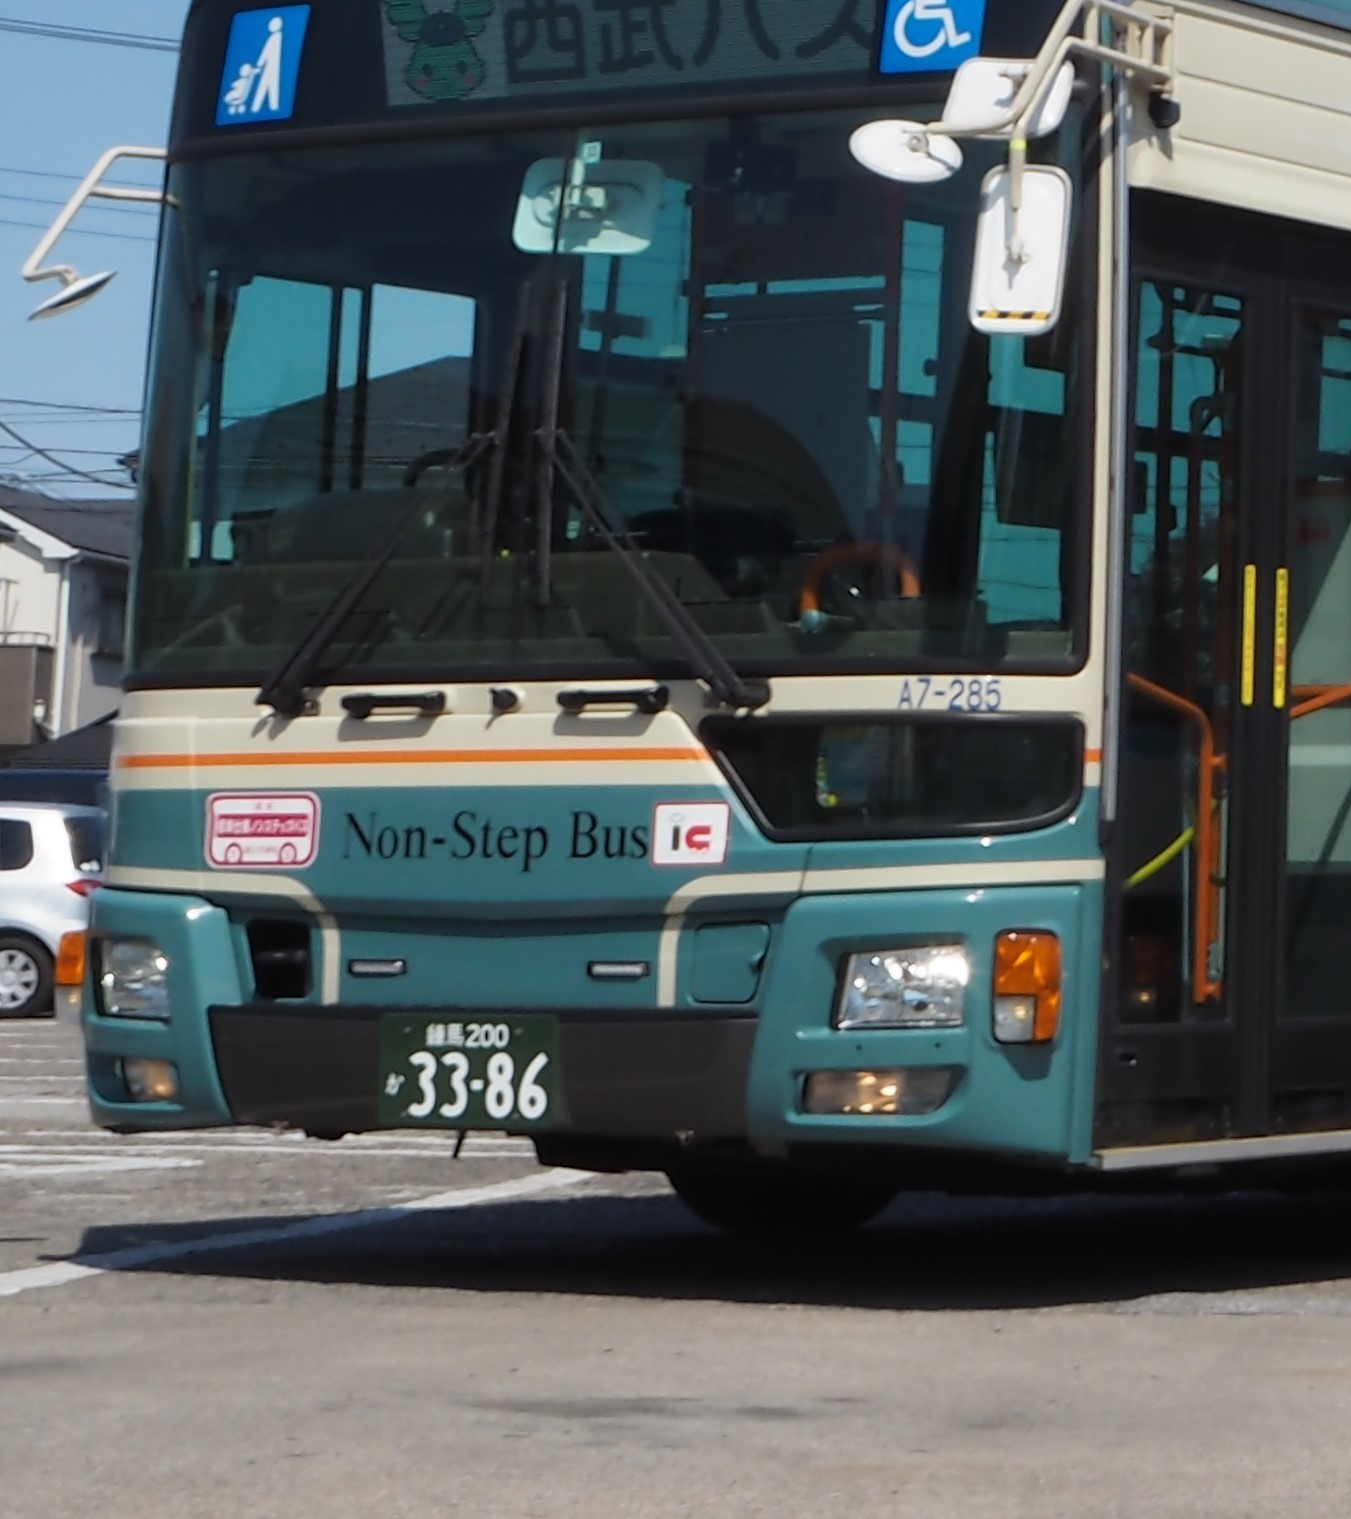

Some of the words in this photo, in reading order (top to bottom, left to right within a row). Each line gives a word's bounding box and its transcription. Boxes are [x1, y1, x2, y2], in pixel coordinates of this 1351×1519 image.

[898, 677, 1002, 711] A7-285
[569, 810, 650, 860] Bus
[407, 1050, 550, 1120] 33-86
